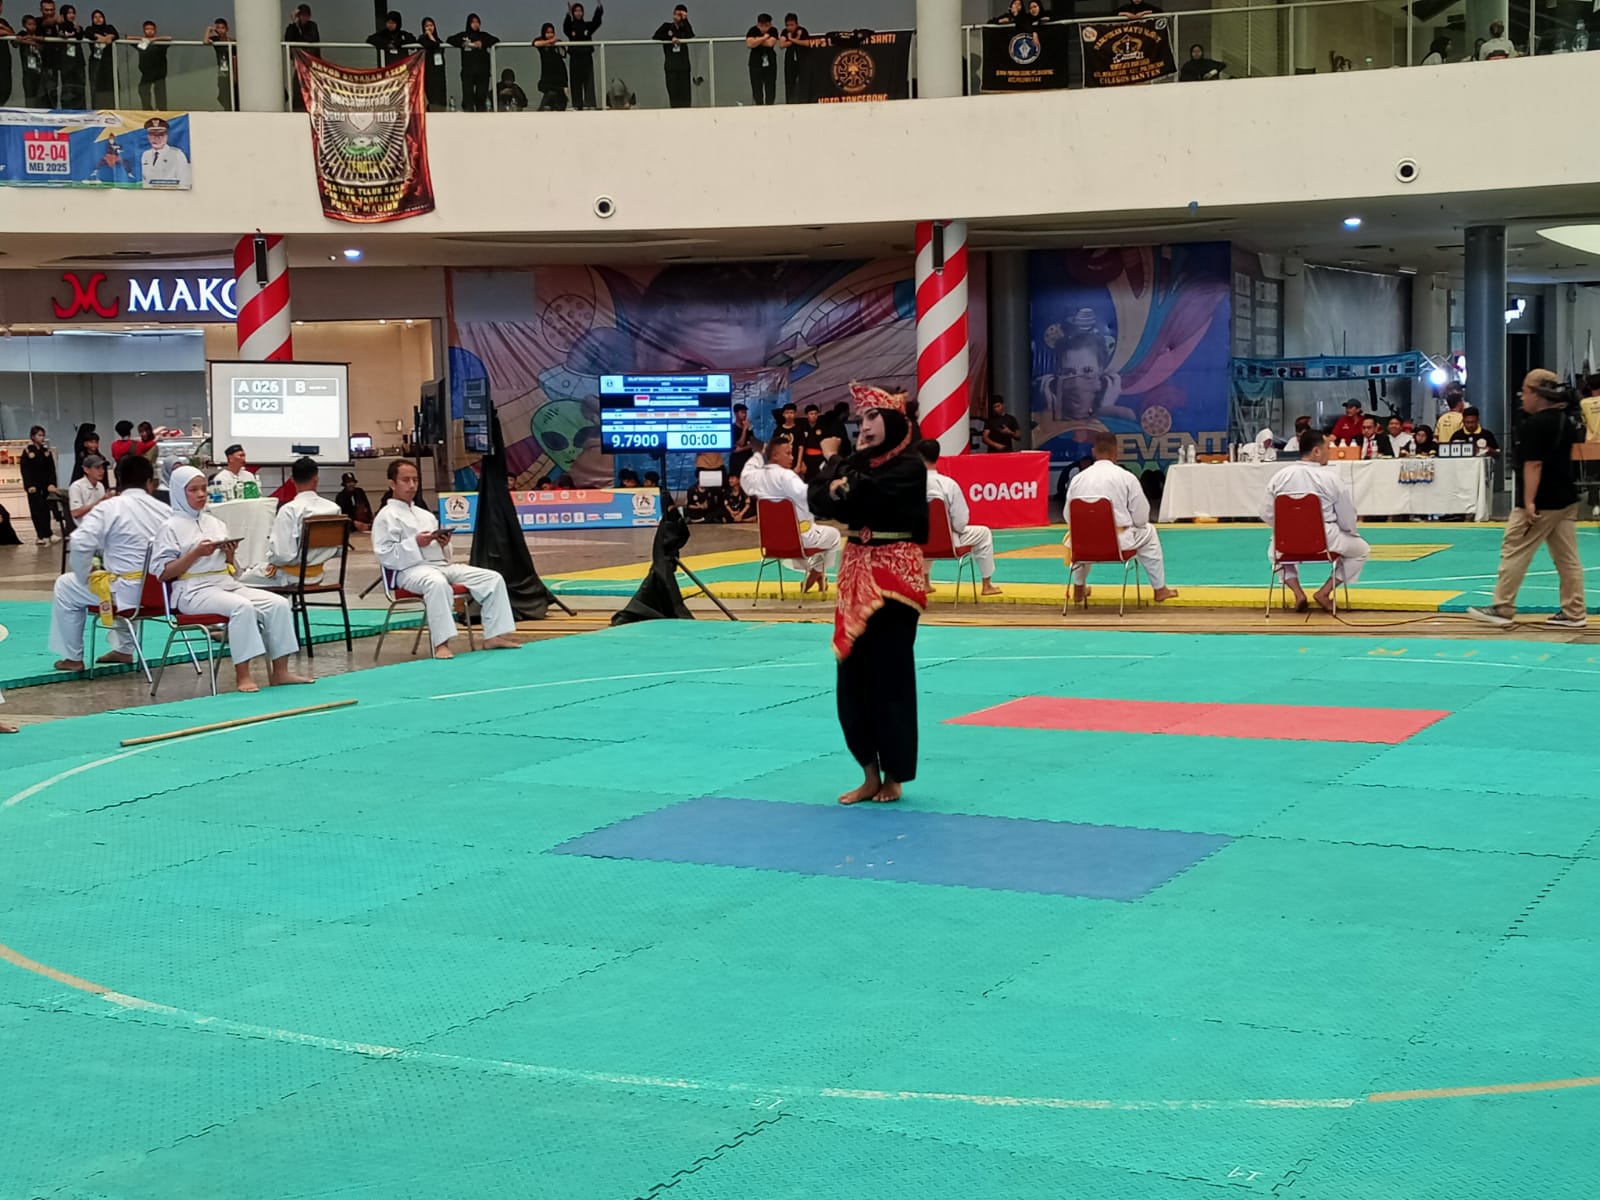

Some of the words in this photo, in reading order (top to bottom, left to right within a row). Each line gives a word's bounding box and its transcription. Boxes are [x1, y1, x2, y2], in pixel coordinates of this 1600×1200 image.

[1131, 69, 1161, 81] BANTEN
[28, 144, 67, 161] 02-04
[29, 162, 44, 171] MEI
[46, 162, 68, 172] 2025
[363, 200, 399, 213] MADIUN
[238, 380, 249, 393] A
[252, 380, 280, 393] 026
[295, 381, 306, 393] B
[238, 398, 250, 411] C
[252, 398, 279, 411] 023
[612, 433, 660, 448] 9.7900
[681, 433, 719, 447] 00:00
[1115, 432, 1228, 461] EVENT
[969, 481, 1038, 502] COACH
